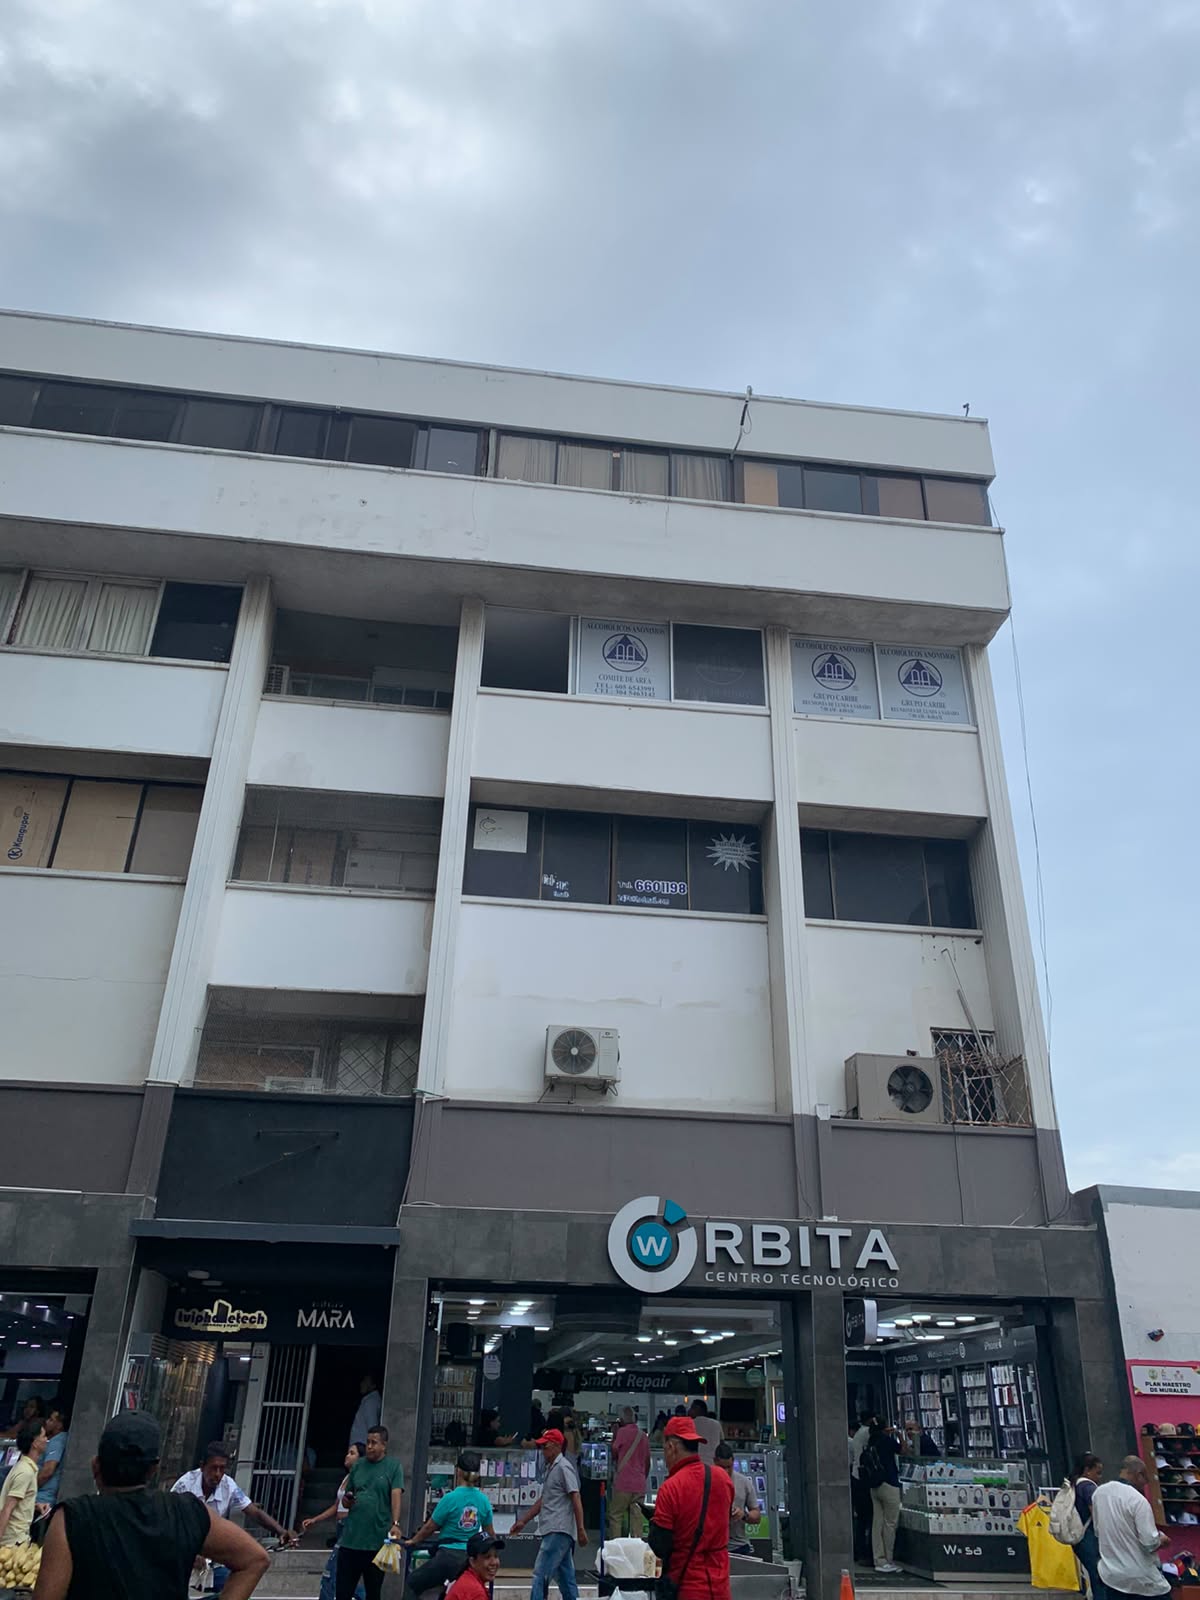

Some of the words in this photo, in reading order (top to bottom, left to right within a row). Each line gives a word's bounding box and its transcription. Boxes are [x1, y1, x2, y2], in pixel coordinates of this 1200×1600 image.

[634, 879, 688, 895] 6601198
[704, 1270, 774, 1285] CENTRO
[779, 1272, 900, 1289] TECNOLÓGICO
[296, 1308, 355, 1329] MARA
[626, 1373, 671, 1391] Repair
